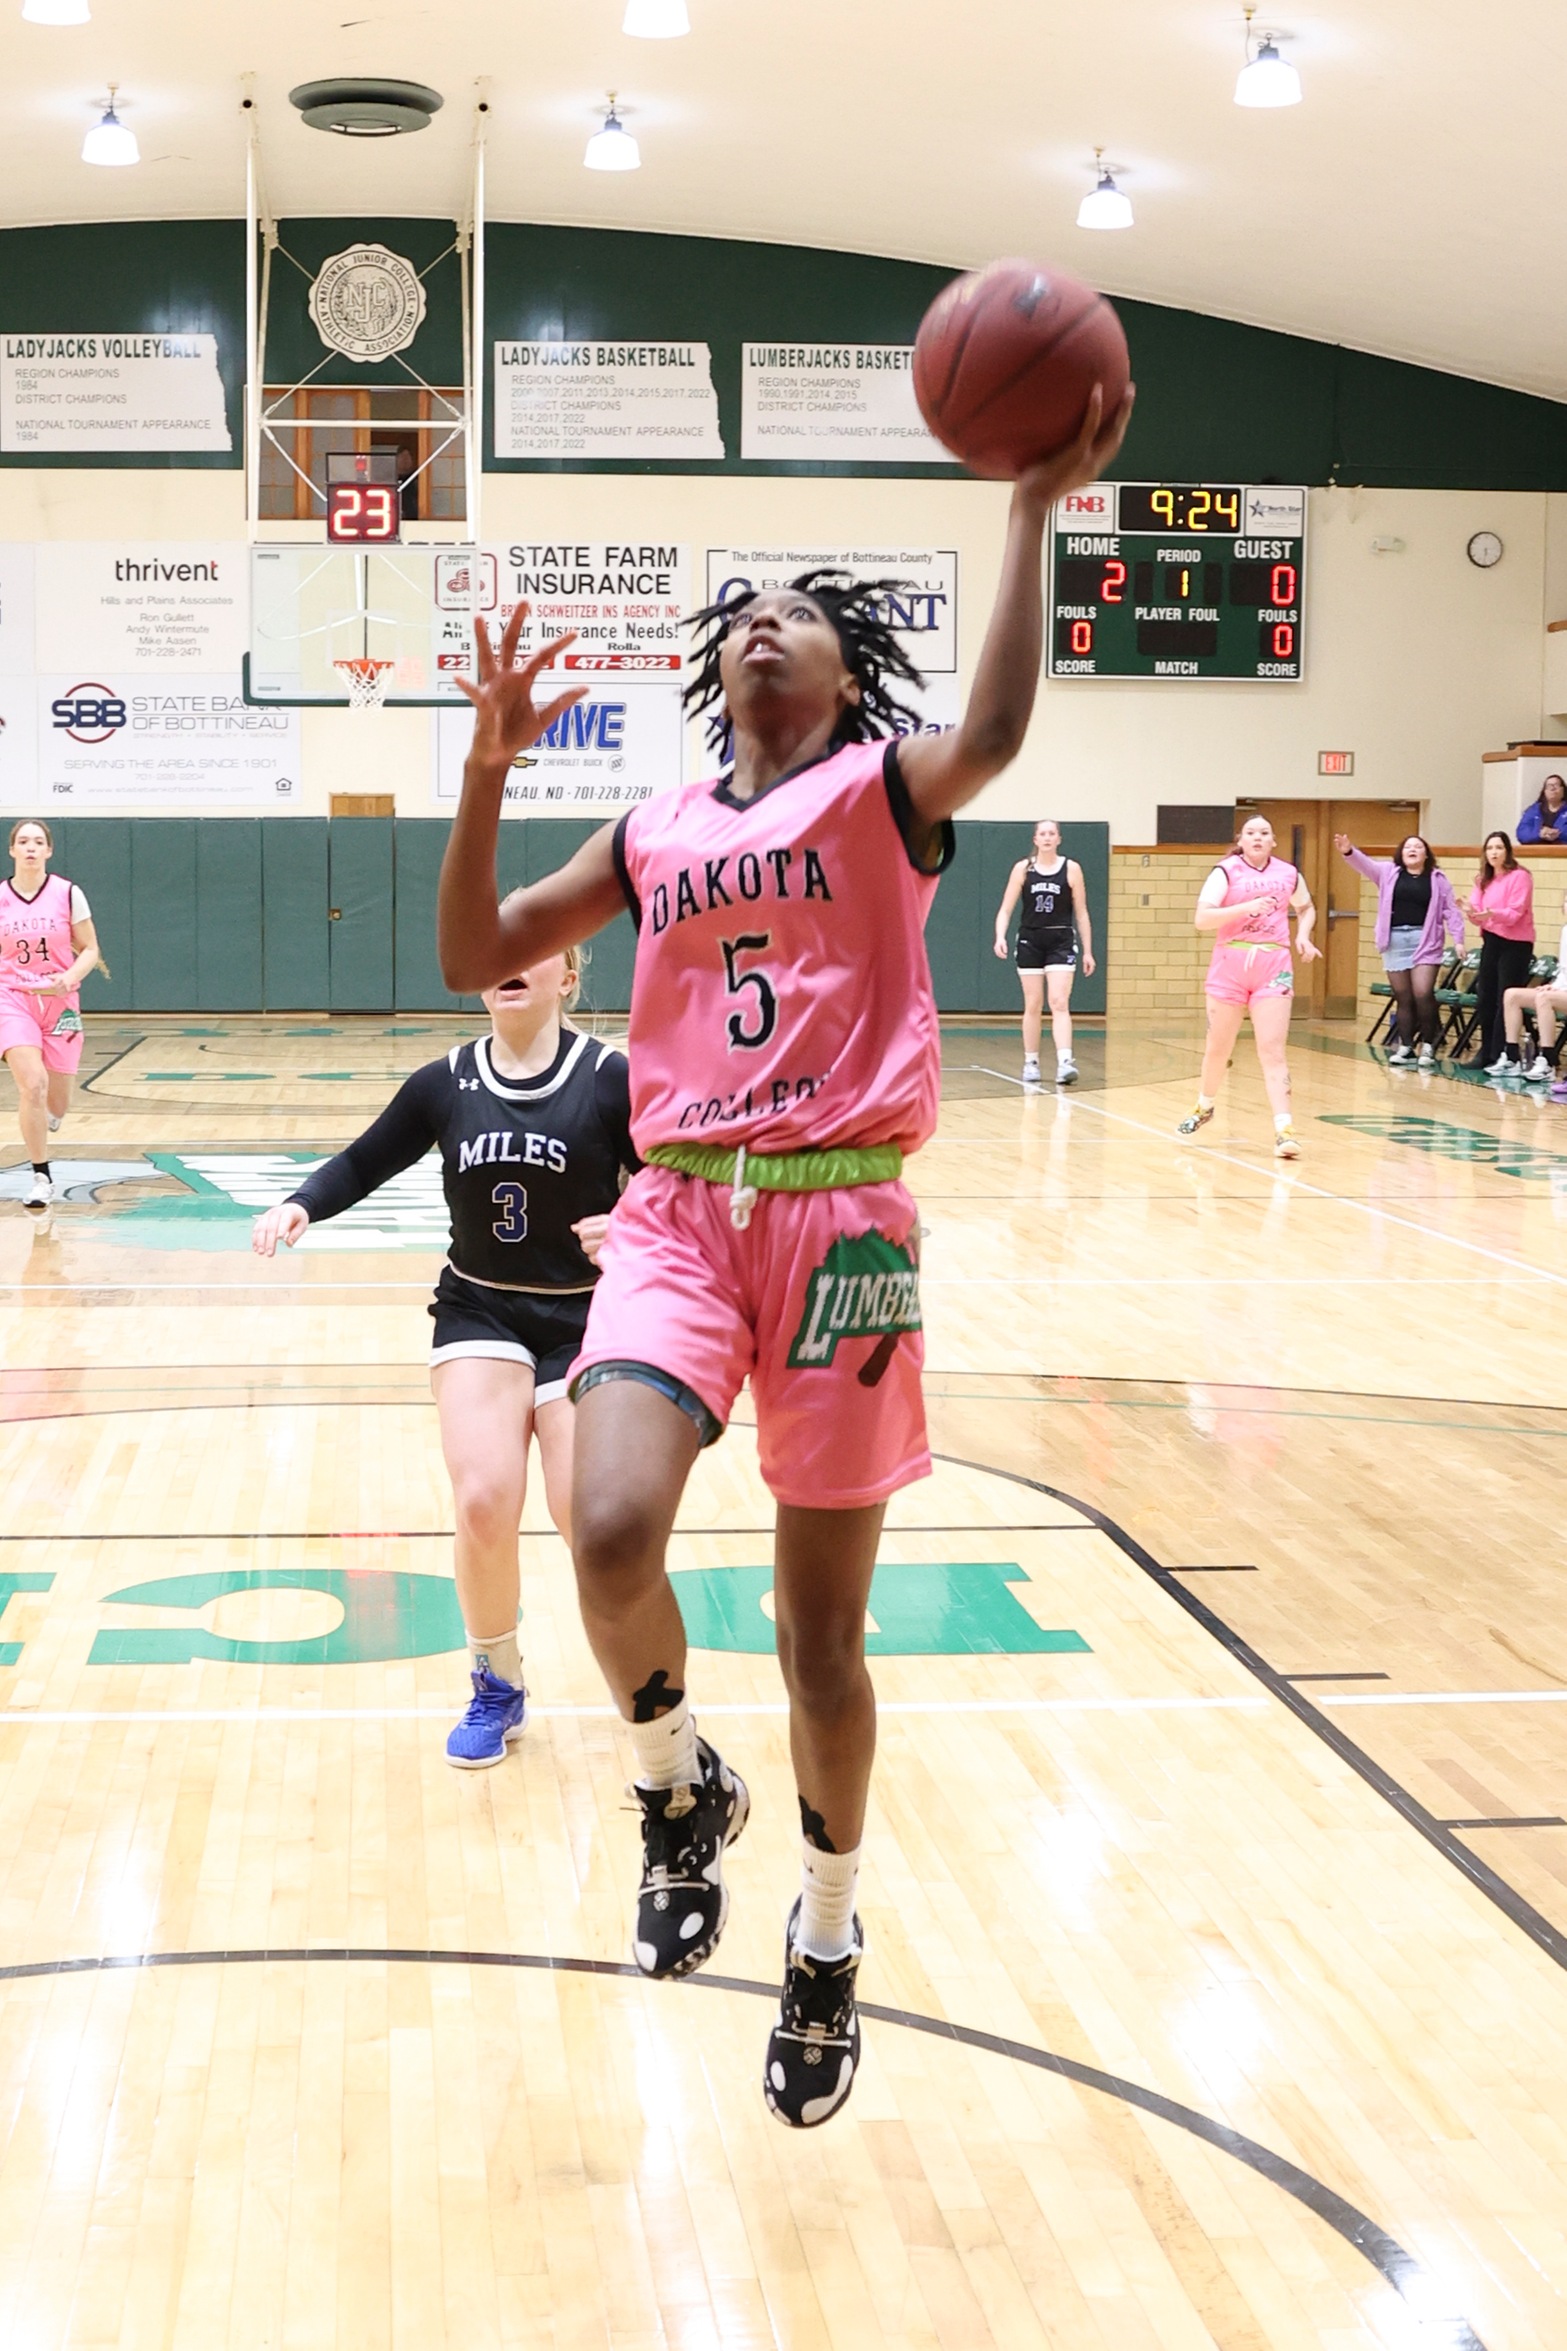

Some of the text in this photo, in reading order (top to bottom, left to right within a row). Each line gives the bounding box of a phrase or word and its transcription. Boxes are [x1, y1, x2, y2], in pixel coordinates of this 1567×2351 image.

[319, 254, 417, 303] NATIONAL JUNIOR COLLEGE
[320, 310, 415, 352] ATHLETIC ASSOCIATION
[6, 339, 201, 358] LADYJACKS VOLLEYBALL
[501, 347, 695, 367] LADYJACKS BASKETBALL
[749, 348, 914, 370] LUMBERJACKS BASKET
[15, 368, 119, 378] REGION CHAMPIONS
[512, 375, 615, 385] REGION CHAMPIONS
[16, 380, 38, 390] 1984
[758, 377, 861, 388] REGION CHAMPIONS
[15, 394, 127, 404] DISTRICT CHAMPIONS
[511, 401, 621, 411] DISTRICT CHAMPIONS
[757, 402, 867, 413] DISTRICT CHAMPIONS
[15, 420, 211, 430] NATIONAL TOURNAMENT APPEARANCE
[511, 426, 704, 437] NATIONAL TOURNAMENT APPEARANCE
[757, 425, 806, 436] NATIONAL
[880, 428, 937, 438] APPEARA
[16, 431, 38, 441] 1984
[1065, 496, 1105, 513] FNB
[1151, 490, 1238, 529] 9:24
[333, 489, 391, 536] 23
[1067, 537, 1120, 556] HOME
[1234, 541, 1294, 559] GUEST
[508, 546, 678, 567] STATE FARM
[732, 551, 933, 564] The Official Newspaper of Bottineau County
[1156, 550, 1201, 562] PERIOD
[115, 559, 219, 582] thrivent
[516, 573, 671, 595] INSURANCE
[1102, 561, 1126, 603] 2
[1181, 570, 1190, 597] 1
[1271, 565, 1296, 606] 0
[125, 596, 143, 605] and
[147, 596, 175, 605] Plains
[179, 596, 233, 605] Associates
[140, 613, 160, 622] Ron
[501, 604, 681, 618] BRN SCHWEITZER INS AGENCY INC
[1057, 606, 1097, 619] FOULS
[1135, 607, 1220, 621] PLAYER FOUL
[1258, 609, 1297, 623] FOULS
[126, 625, 151, 635] Andy
[499, 623, 532, 638] Yur
[139, 637, 162, 645] Mike
[1072, 622, 1092, 653] 0
[1273, 625, 1293, 656] 0
[607, 642, 641, 651] Rolla
[575, 656, 671, 669] 477-3022
[1056, 660, 1096, 673] SCORE
[1155, 661, 1198, 675] MATCH
[1257, 663, 1297, 676] SCORE
[132, 696, 281, 711] STATE BA
[51, 699, 127, 728] SBB
[132, 717, 289, 730] OF BOTTINEAU
[528, 702, 627, 750] RIVE
[64, 759, 277, 770] SERVING THE AREA SINCE 1901
[543, 758, 603, 767] CHEVROLET BUICK
[1325, 753, 1347, 771] EXIT
[53, 784, 74, 793] FDIC
[545, 786, 564, 799] ND
[652, 848, 833, 936] DAKOTA
[1031, 882, 1060, 894] MILES
[1035, 895, 1054, 913] 14
[4, 917, 57, 936] DAKOTA
[16, 937, 50, 965] 34
[719, 929, 778, 1054] 5
[458, 1131, 567, 1174] MILES
[492, 1182, 527, 1242] 3
